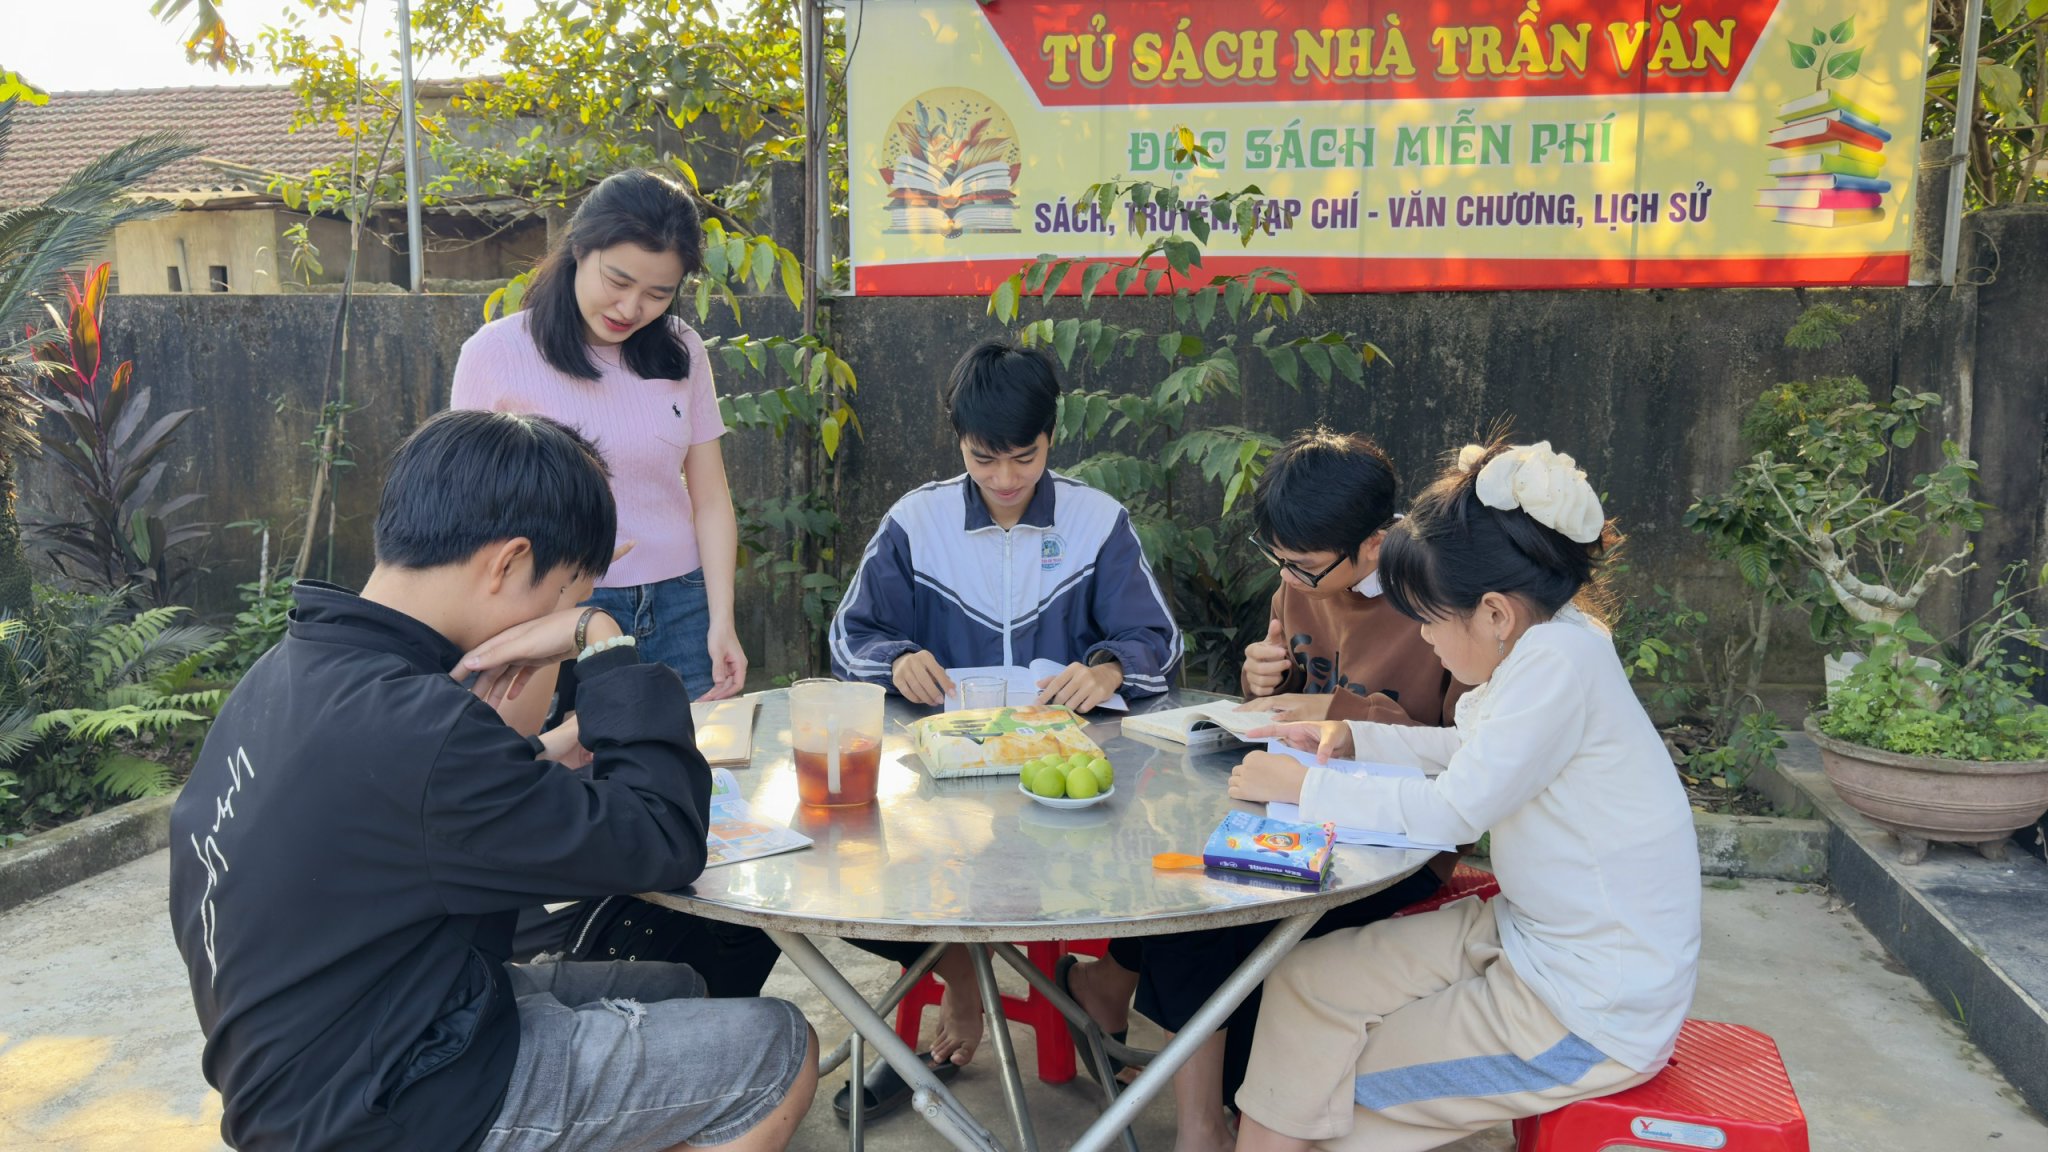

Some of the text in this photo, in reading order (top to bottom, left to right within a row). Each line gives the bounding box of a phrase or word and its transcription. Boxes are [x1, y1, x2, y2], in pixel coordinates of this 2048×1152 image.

[1042, 0, 1737, 84] TỦ SÁCH NHÀ TRẦN VĂN
[1245, 118, 1375, 169] SÁCH
[1393, 108, 1512, 166] MIỄN
[1530, 112, 1616, 164] PHÍ
[1034, 196, 1116, 236] SÁCH,
[1311, 190, 1360, 229] CHÍ
[1388, 189, 1446, 228] VĂN
[1456, 191, 1584, 229] CHƯƠNG,
[1594, 192, 1658, 231] LỊCH
[1669, 180, 1712, 224] SỬ
